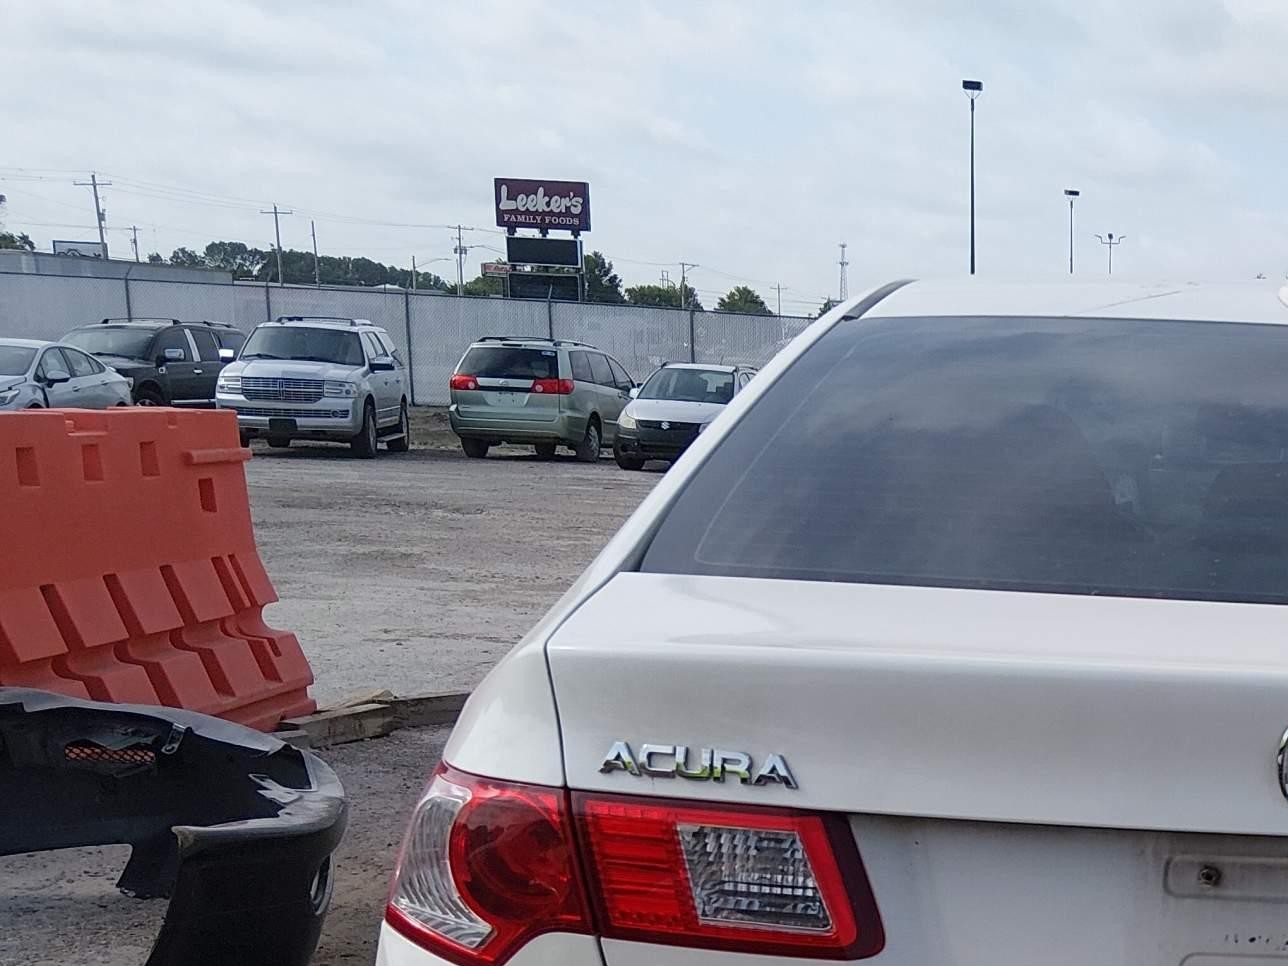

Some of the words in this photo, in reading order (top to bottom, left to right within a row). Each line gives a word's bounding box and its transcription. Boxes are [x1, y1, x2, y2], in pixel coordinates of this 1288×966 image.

[499, 184, 584, 214] Leeker's
[503, 213, 542, 224] FAMILY
[544, 215, 580, 225] FOODS
[600, 741, 799, 790] ACURA
